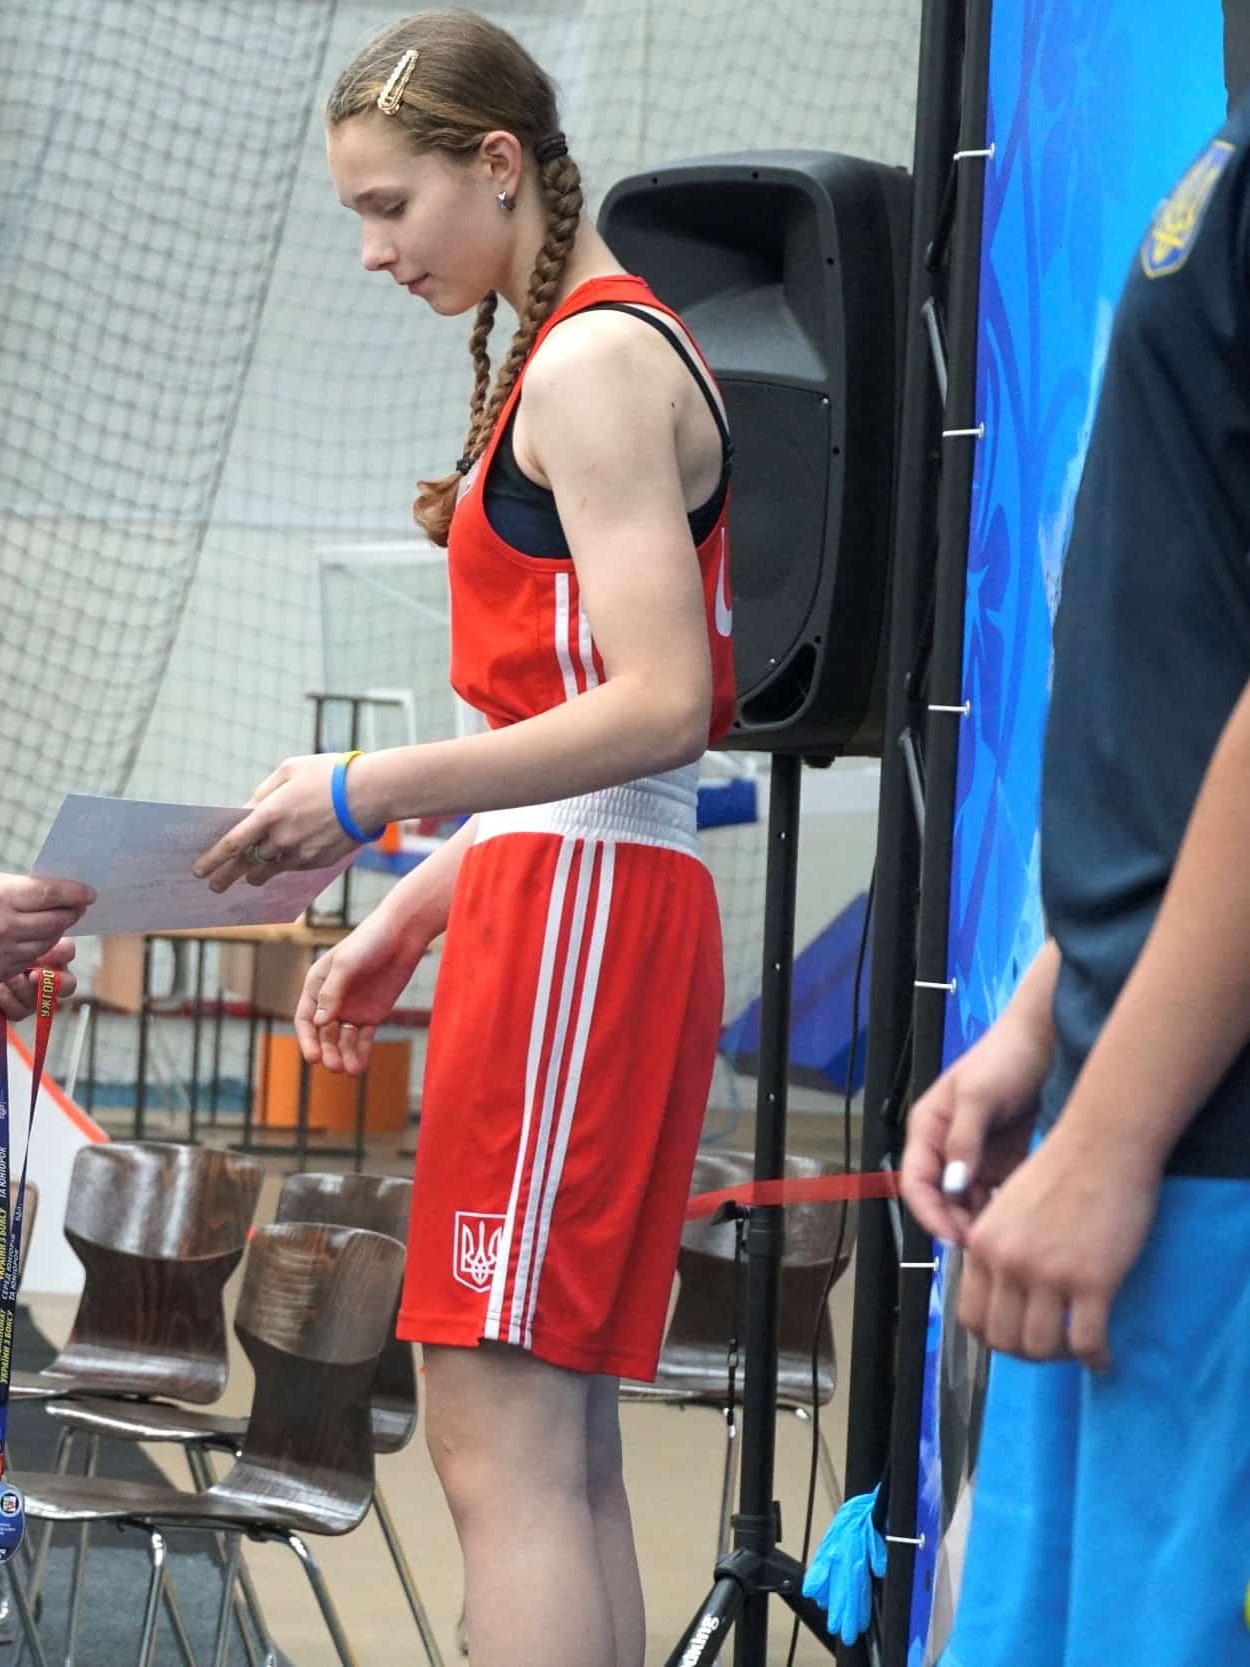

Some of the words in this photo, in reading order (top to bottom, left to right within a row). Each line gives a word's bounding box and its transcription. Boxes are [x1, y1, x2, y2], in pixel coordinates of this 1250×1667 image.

[40, 969, 54, 1017] УЖГОРО
[4, 1310, 14, 1338] БОКСУ
[0, 1346, 10, 1384] УКРАЇНИ
